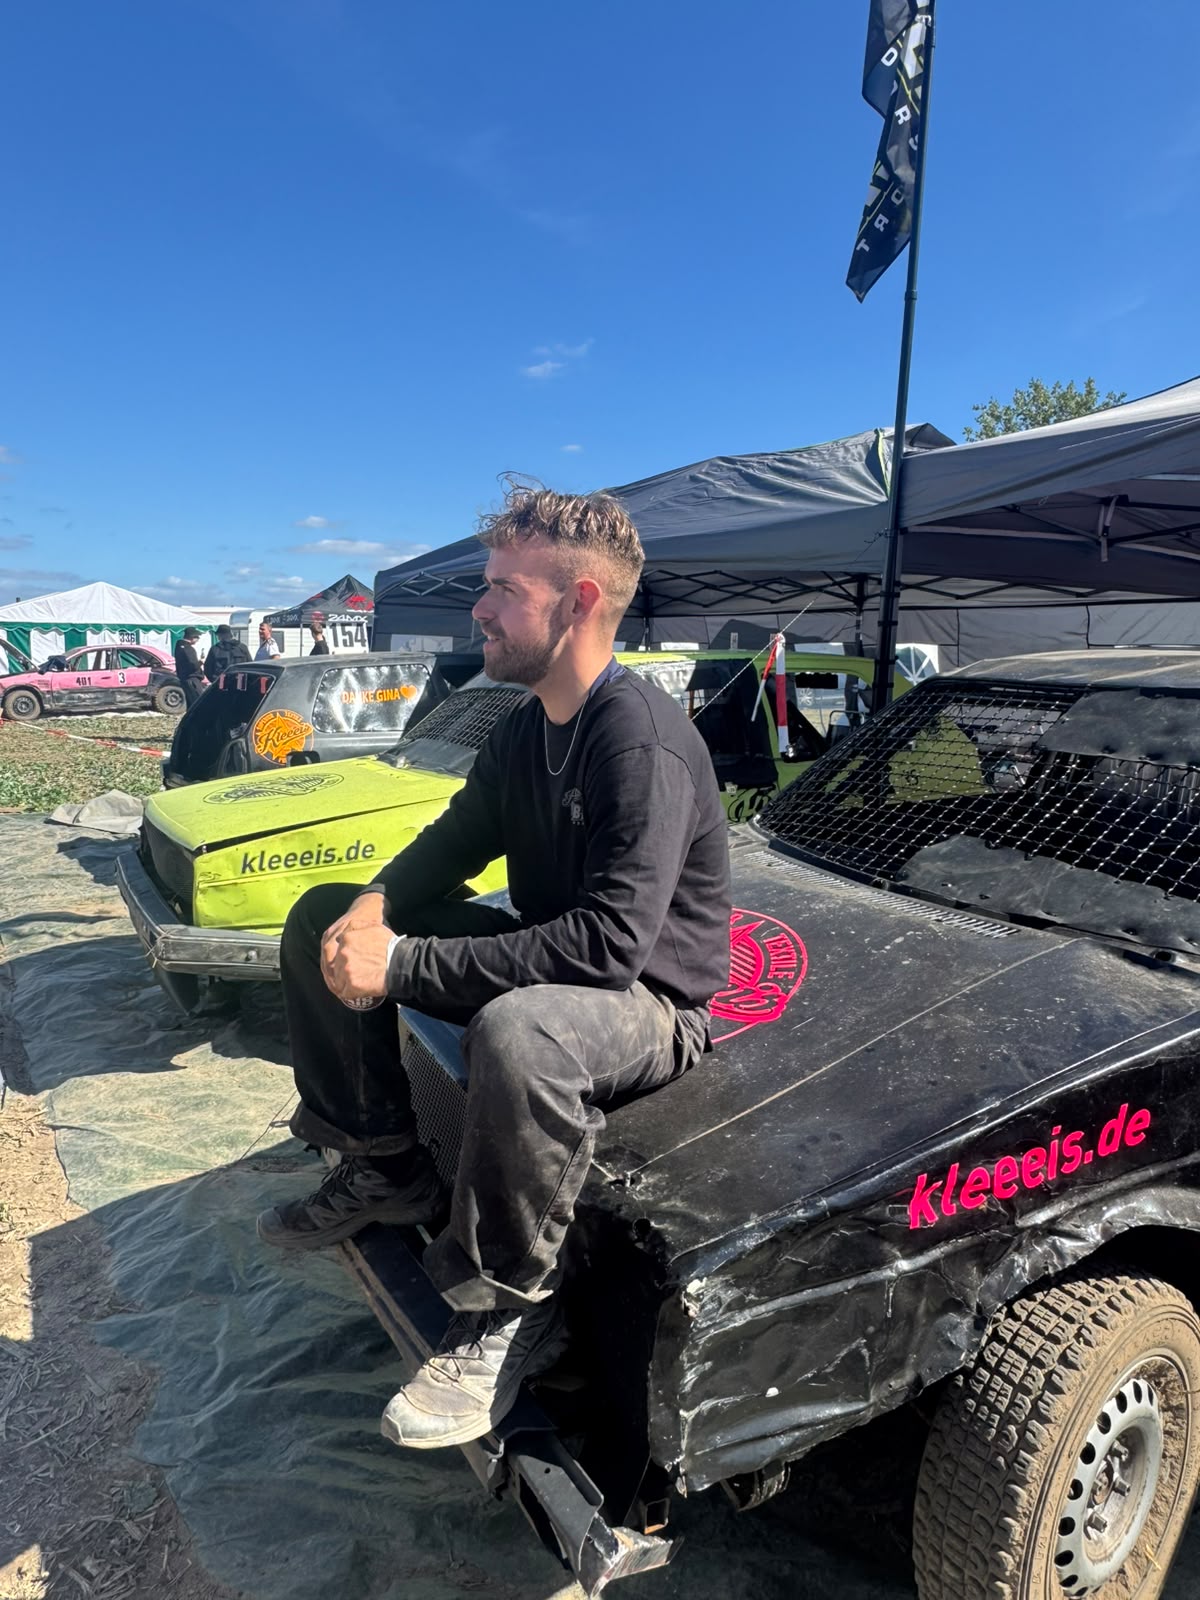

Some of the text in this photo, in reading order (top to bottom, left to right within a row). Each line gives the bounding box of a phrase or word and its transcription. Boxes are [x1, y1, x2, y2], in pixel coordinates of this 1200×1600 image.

[119, 632, 136, 643] 336
[329, 621, 367, 648] 154
[76, 677, 91, 686] 401
[118, 672, 125, 684] 3
[341, 687, 401, 704] DAKE GINA
[240, 839, 376, 874] kleeeis.de
[763, 932, 798, 979] TEXTILE
[909, 1102, 1151, 1230] kleeeis.de
